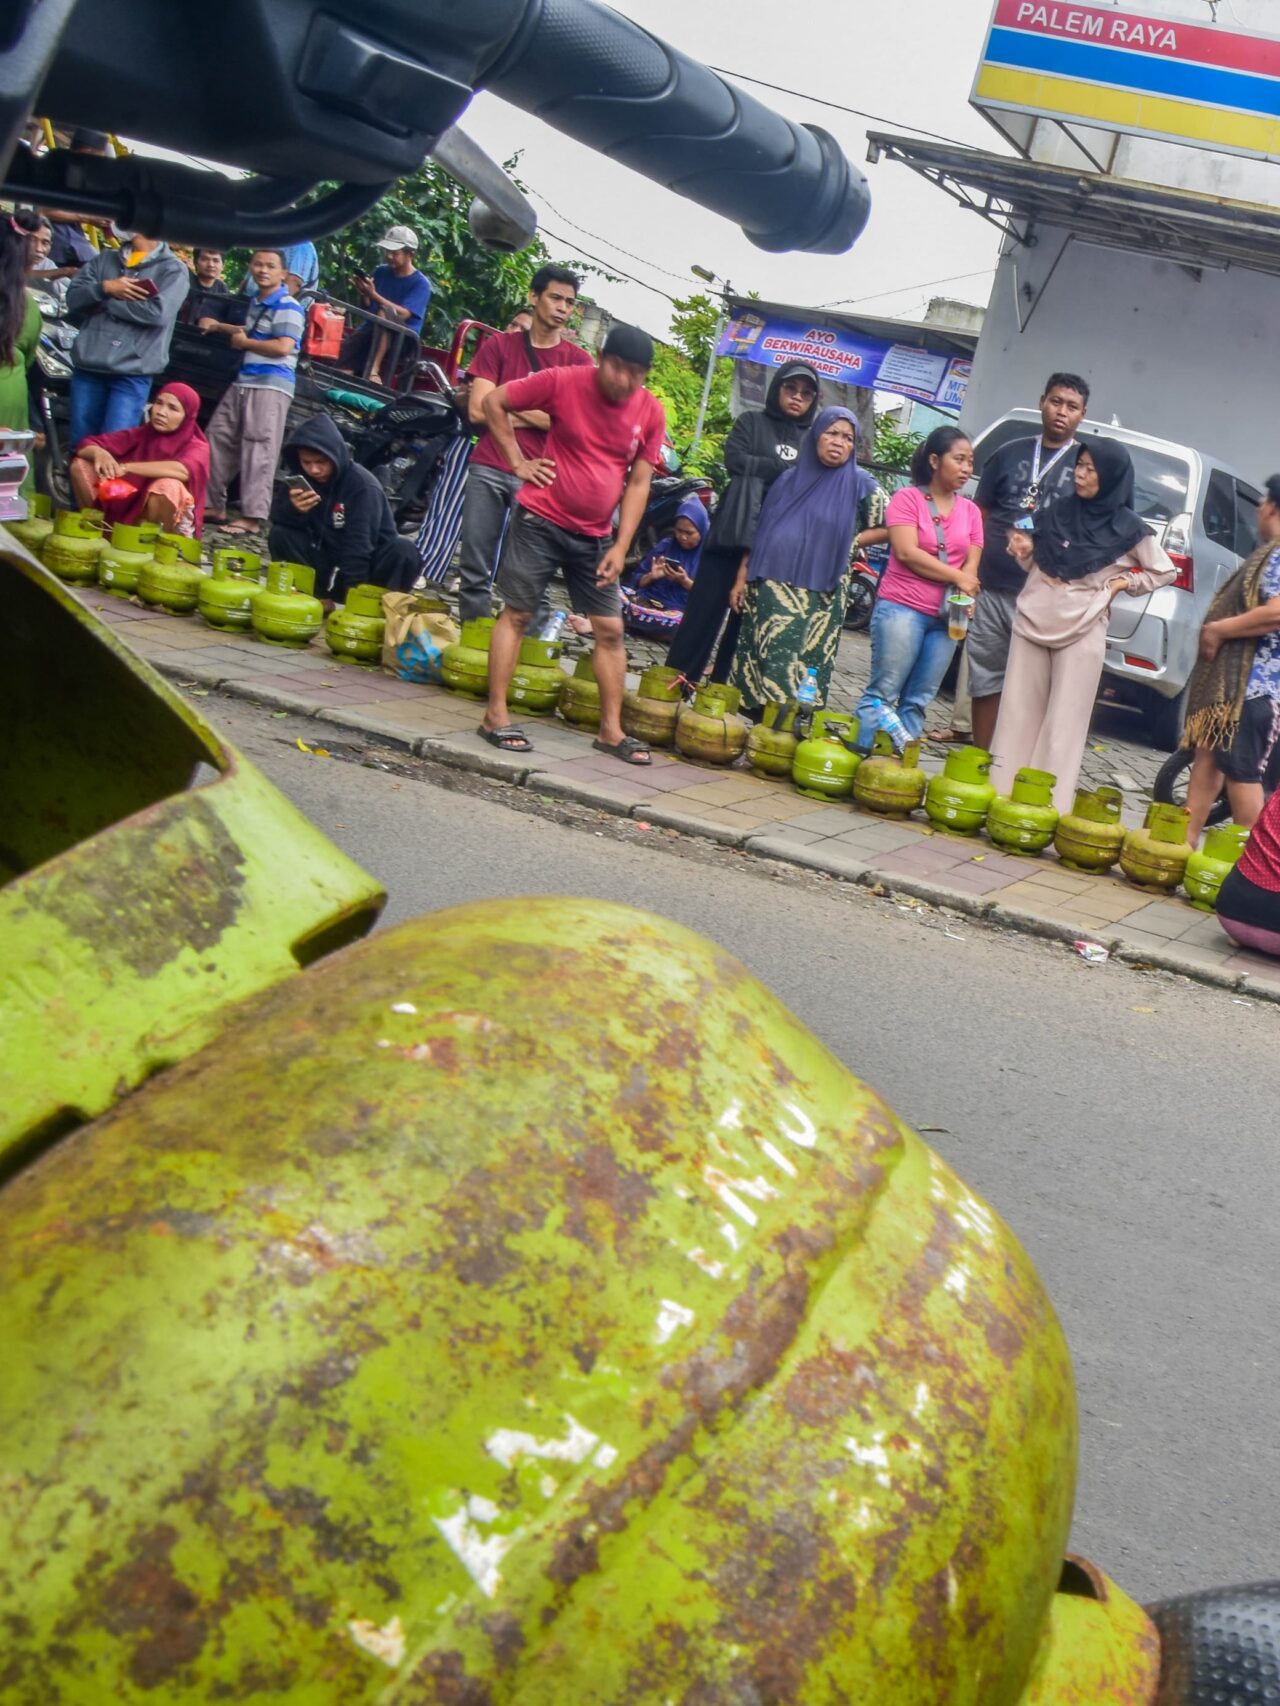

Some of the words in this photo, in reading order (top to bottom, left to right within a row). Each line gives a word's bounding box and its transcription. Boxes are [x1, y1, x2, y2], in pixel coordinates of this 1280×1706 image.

[1016, 1, 1104, 37] PALEM
[1109, 18, 1178, 50] RAYA
[805, 330, 836, 344] AYO
[763, 338, 861, 368] BERWIRAUSAHA
